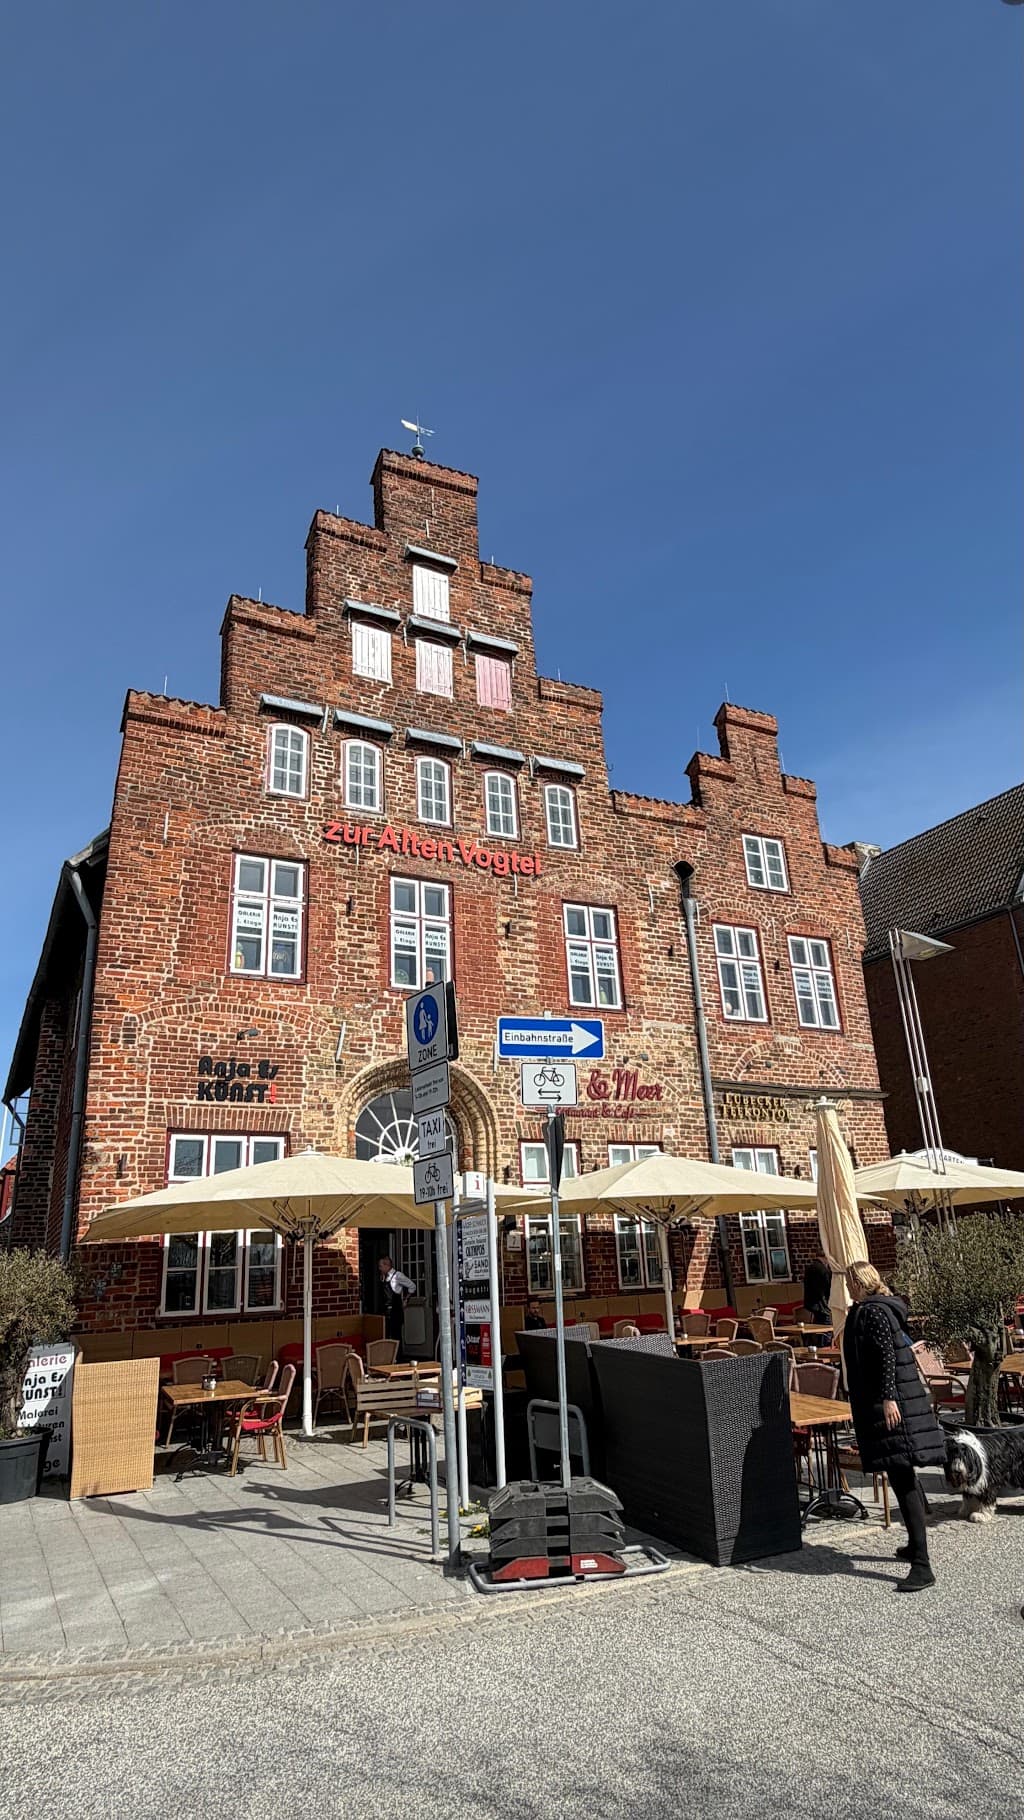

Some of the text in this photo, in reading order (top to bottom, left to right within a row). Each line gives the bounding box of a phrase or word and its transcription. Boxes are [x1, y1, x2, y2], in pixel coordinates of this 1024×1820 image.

[324, 821, 542, 876] zur Alten Vogtei
[504, 1032, 574, 1043] Einbahnstraße
[418, 1044, 438, 1062] ZONE
[198, 1056, 251, 1081] Anja
[612, 1068, 663, 1101] Meer
[421, 1117, 441, 1138] TAXI
[427, 1138, 436, 1150] frei
[437, 1181, 448, 1195] frei
